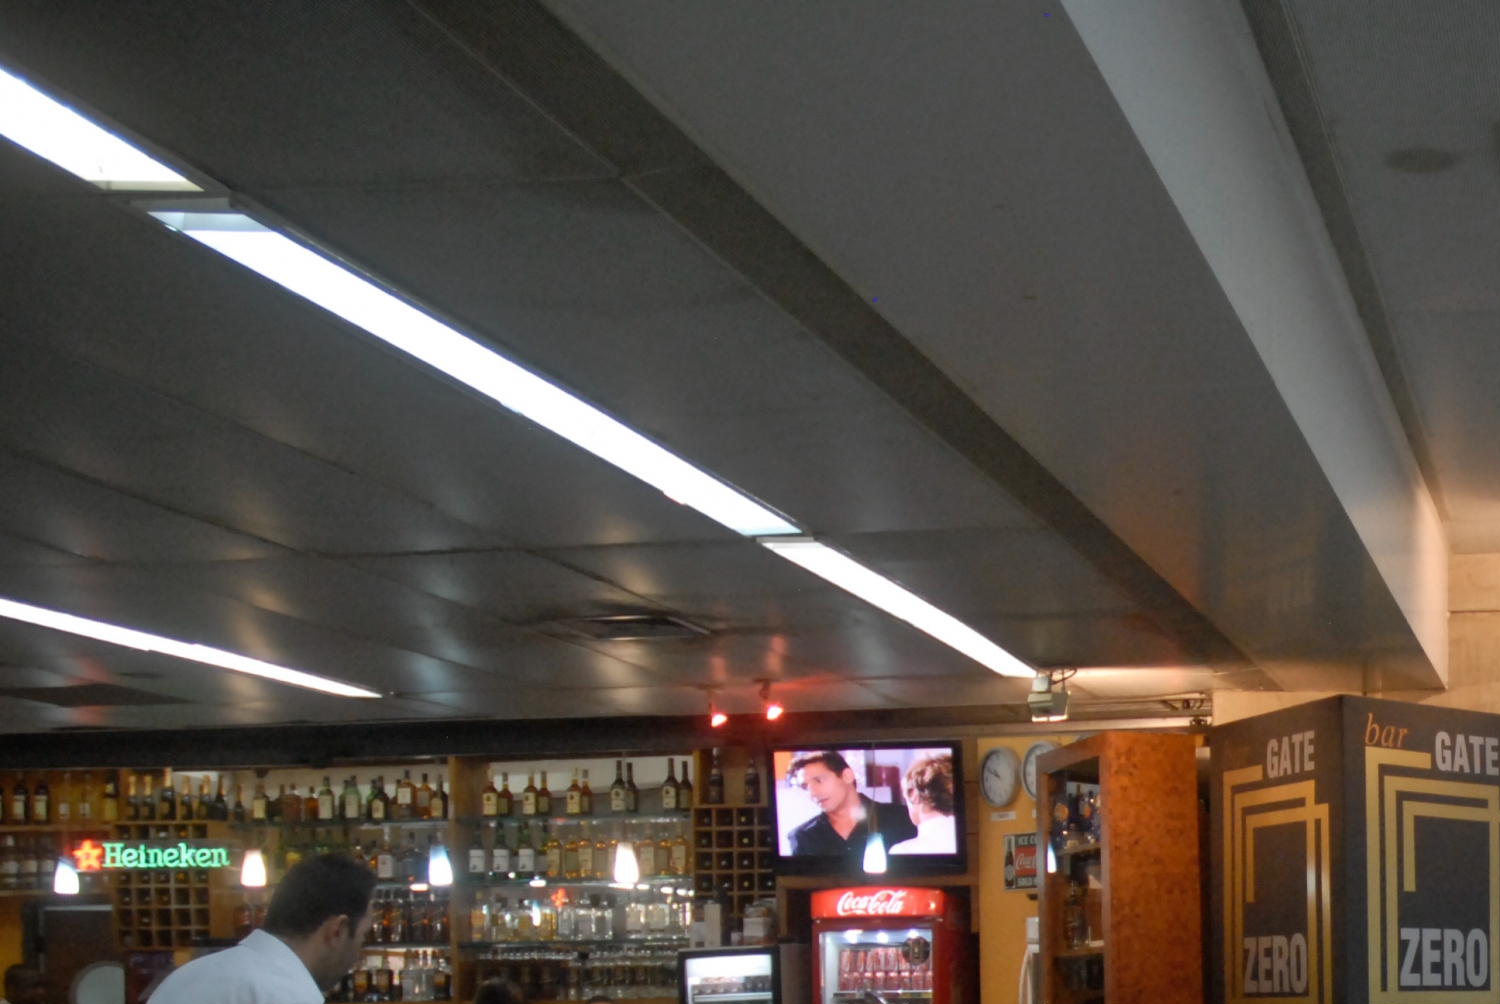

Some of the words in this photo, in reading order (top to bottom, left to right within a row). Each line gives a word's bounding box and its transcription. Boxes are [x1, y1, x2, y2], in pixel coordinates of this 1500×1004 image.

[1266, 730, 1315, 778] GATE
[1365, 712, 1408, 748] bar
[1435, 731, 1500, 776] GATE
[102, 842, 231, 868] Heineken
[1243, 933, 1308, 994] ZERO
[1400, 928, 1488, 987] ZERO
